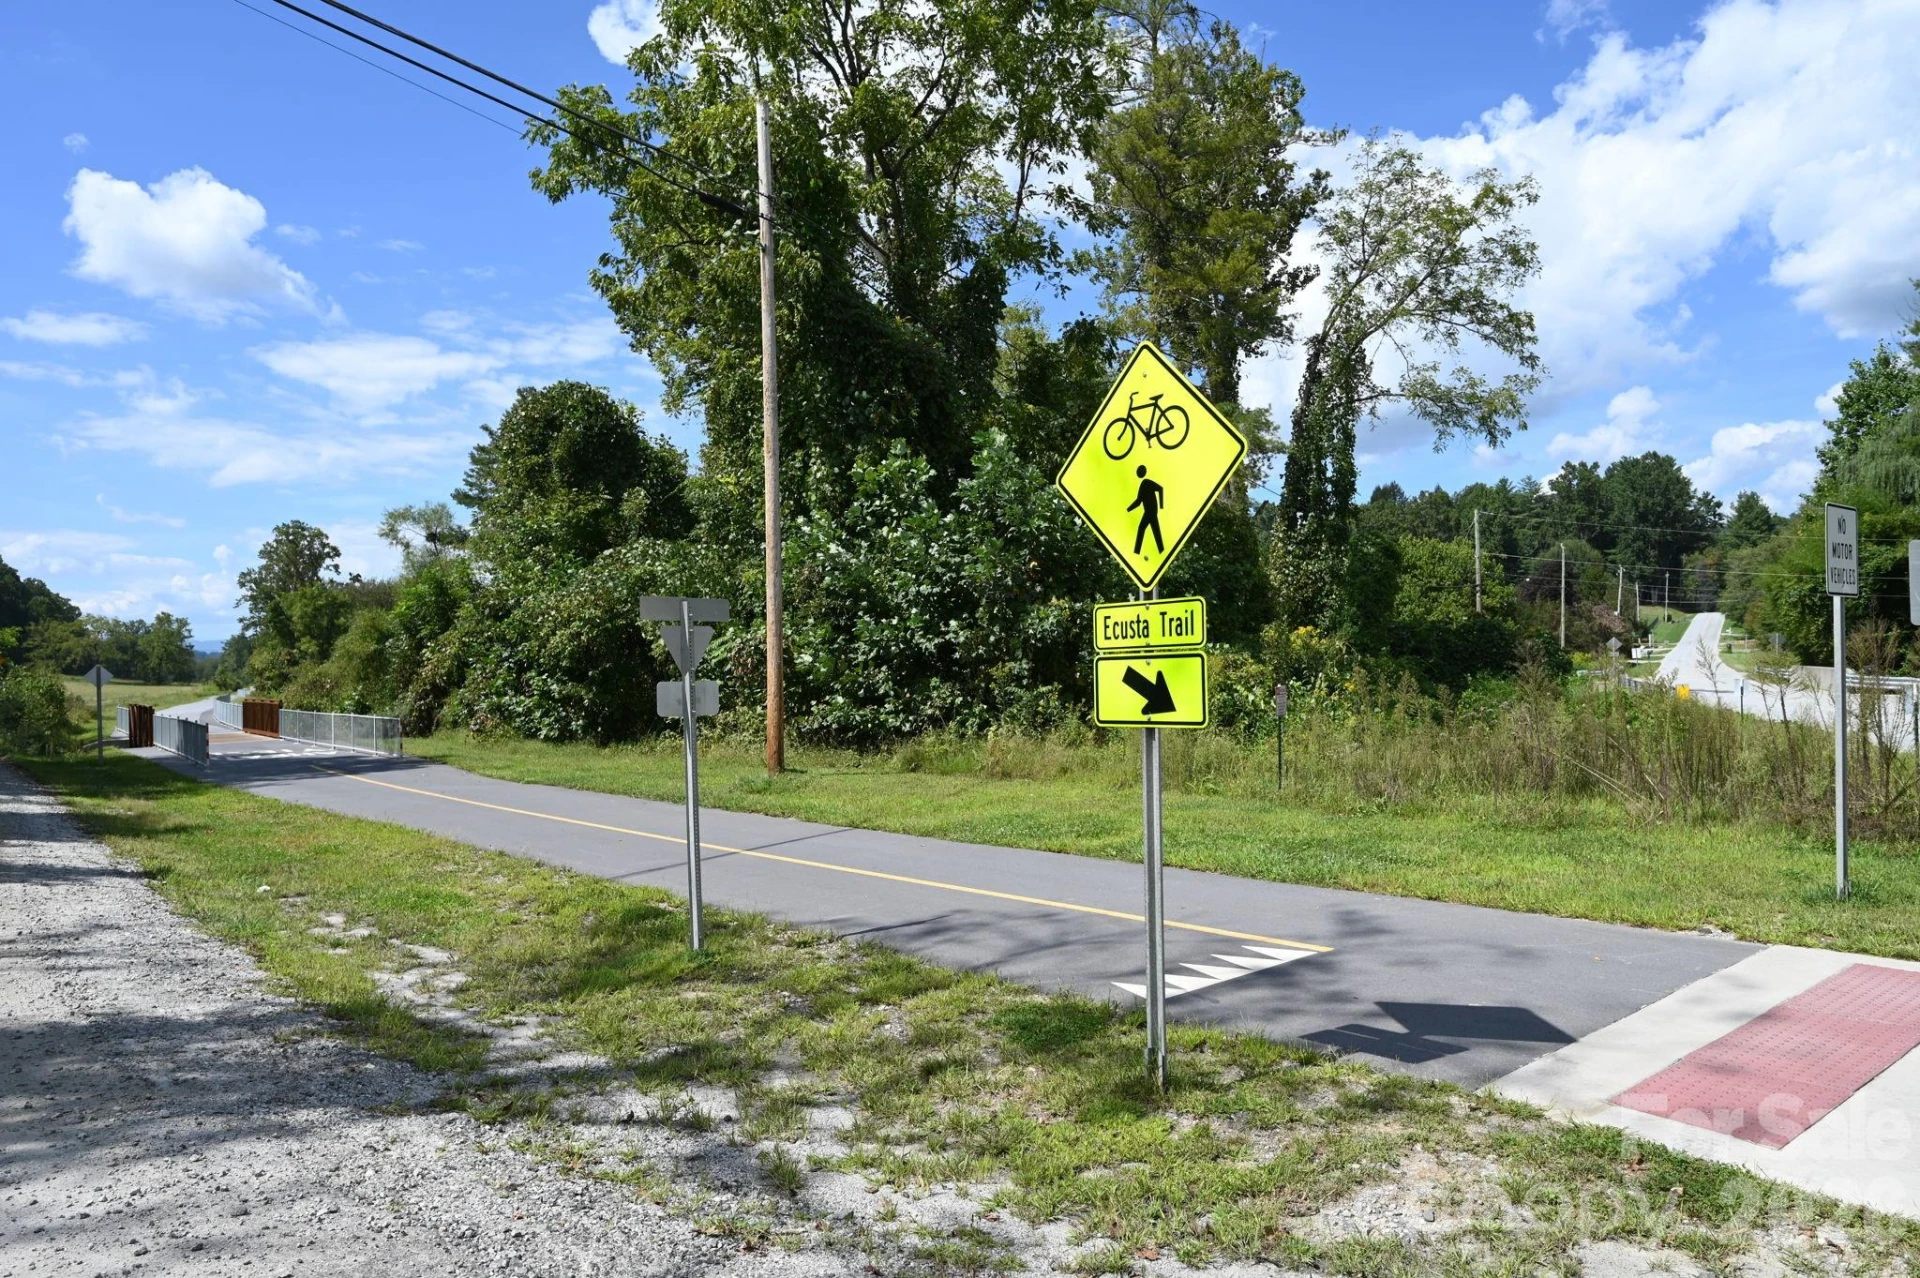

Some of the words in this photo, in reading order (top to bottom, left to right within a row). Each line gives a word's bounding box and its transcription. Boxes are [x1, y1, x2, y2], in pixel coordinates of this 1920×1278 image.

[1837, 518, 1846, 535] NO
[1832, 542, 1853, 560] MOTOR
[1830, 567, 1856, 585] VEHICLES
[1103, 614, 1150, 640] Ecusta
[1159, 609, 1195, 637] Trail
